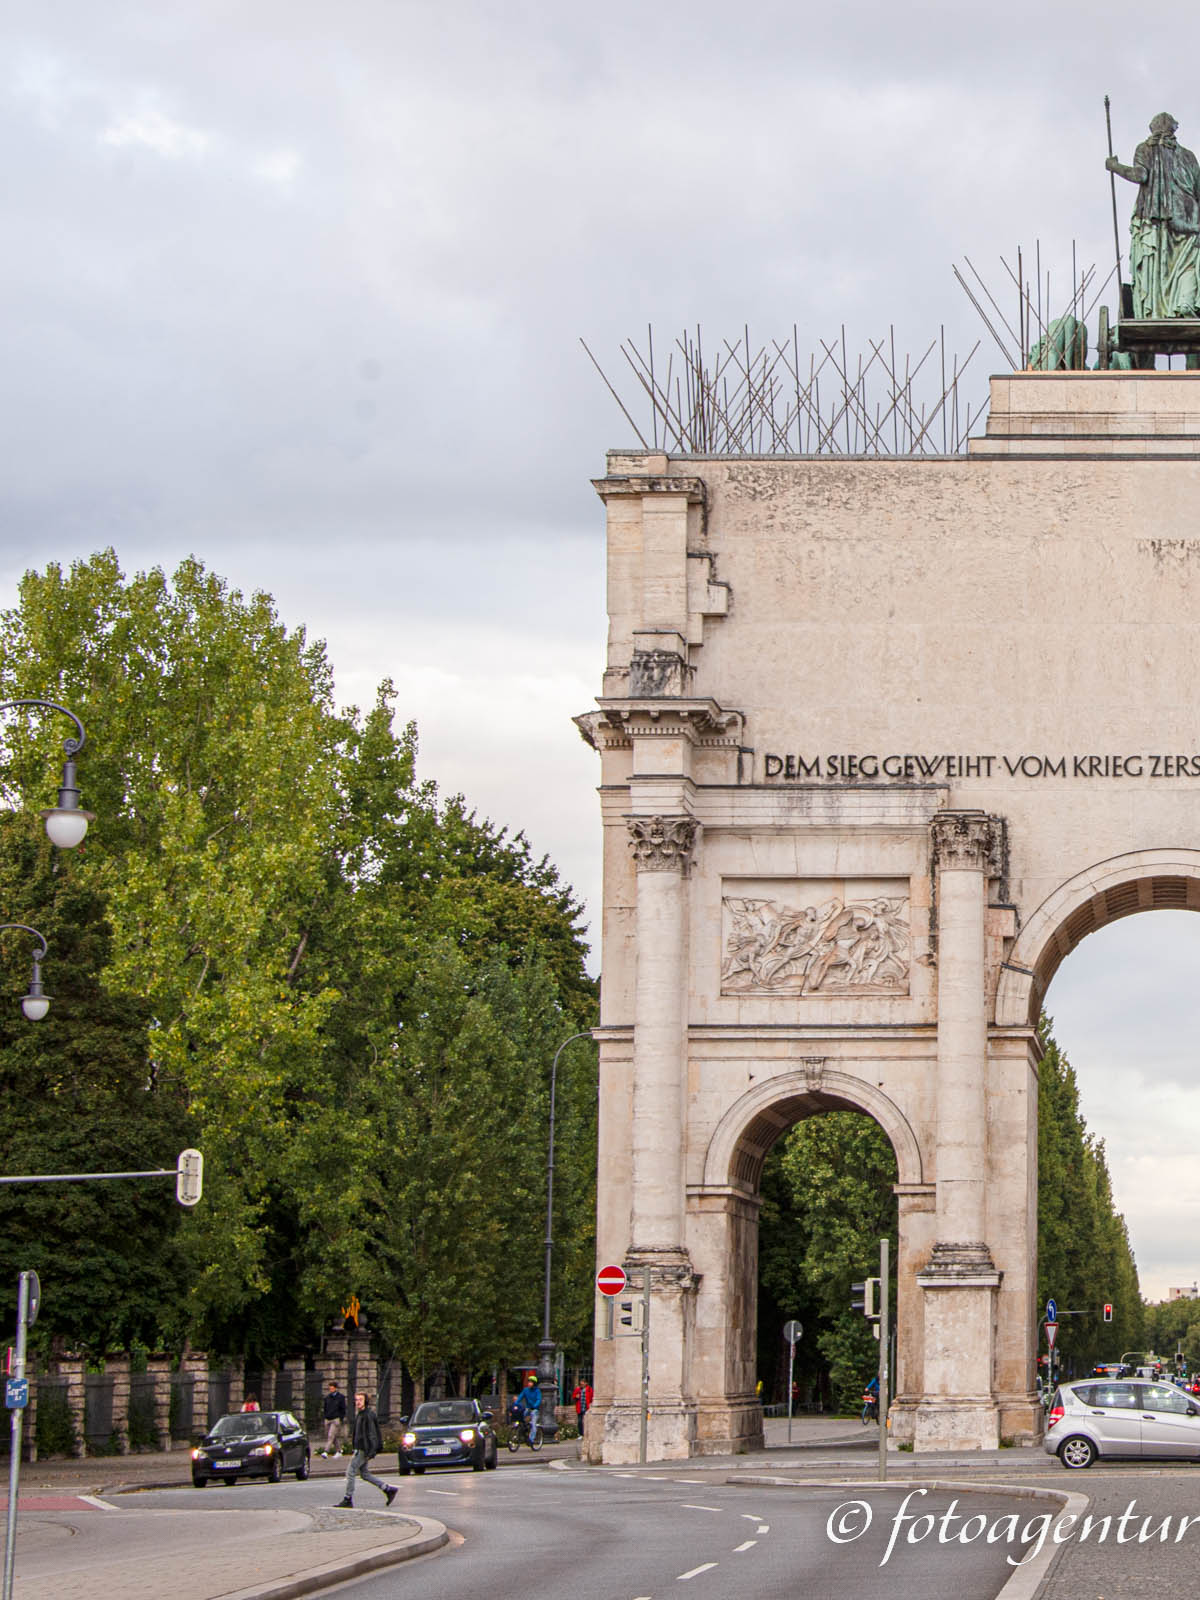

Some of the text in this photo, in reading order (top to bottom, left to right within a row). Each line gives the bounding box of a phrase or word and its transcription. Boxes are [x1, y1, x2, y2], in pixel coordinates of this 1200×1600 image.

[764, 754, 820, 777] DEM
[827, 754, 880, 777] SIEG
[883, 754, 997, 777] GEWEIHT
[1003, 755, 1067, 777] VOM
[1073, 755, 1143, 777] KRIEG
